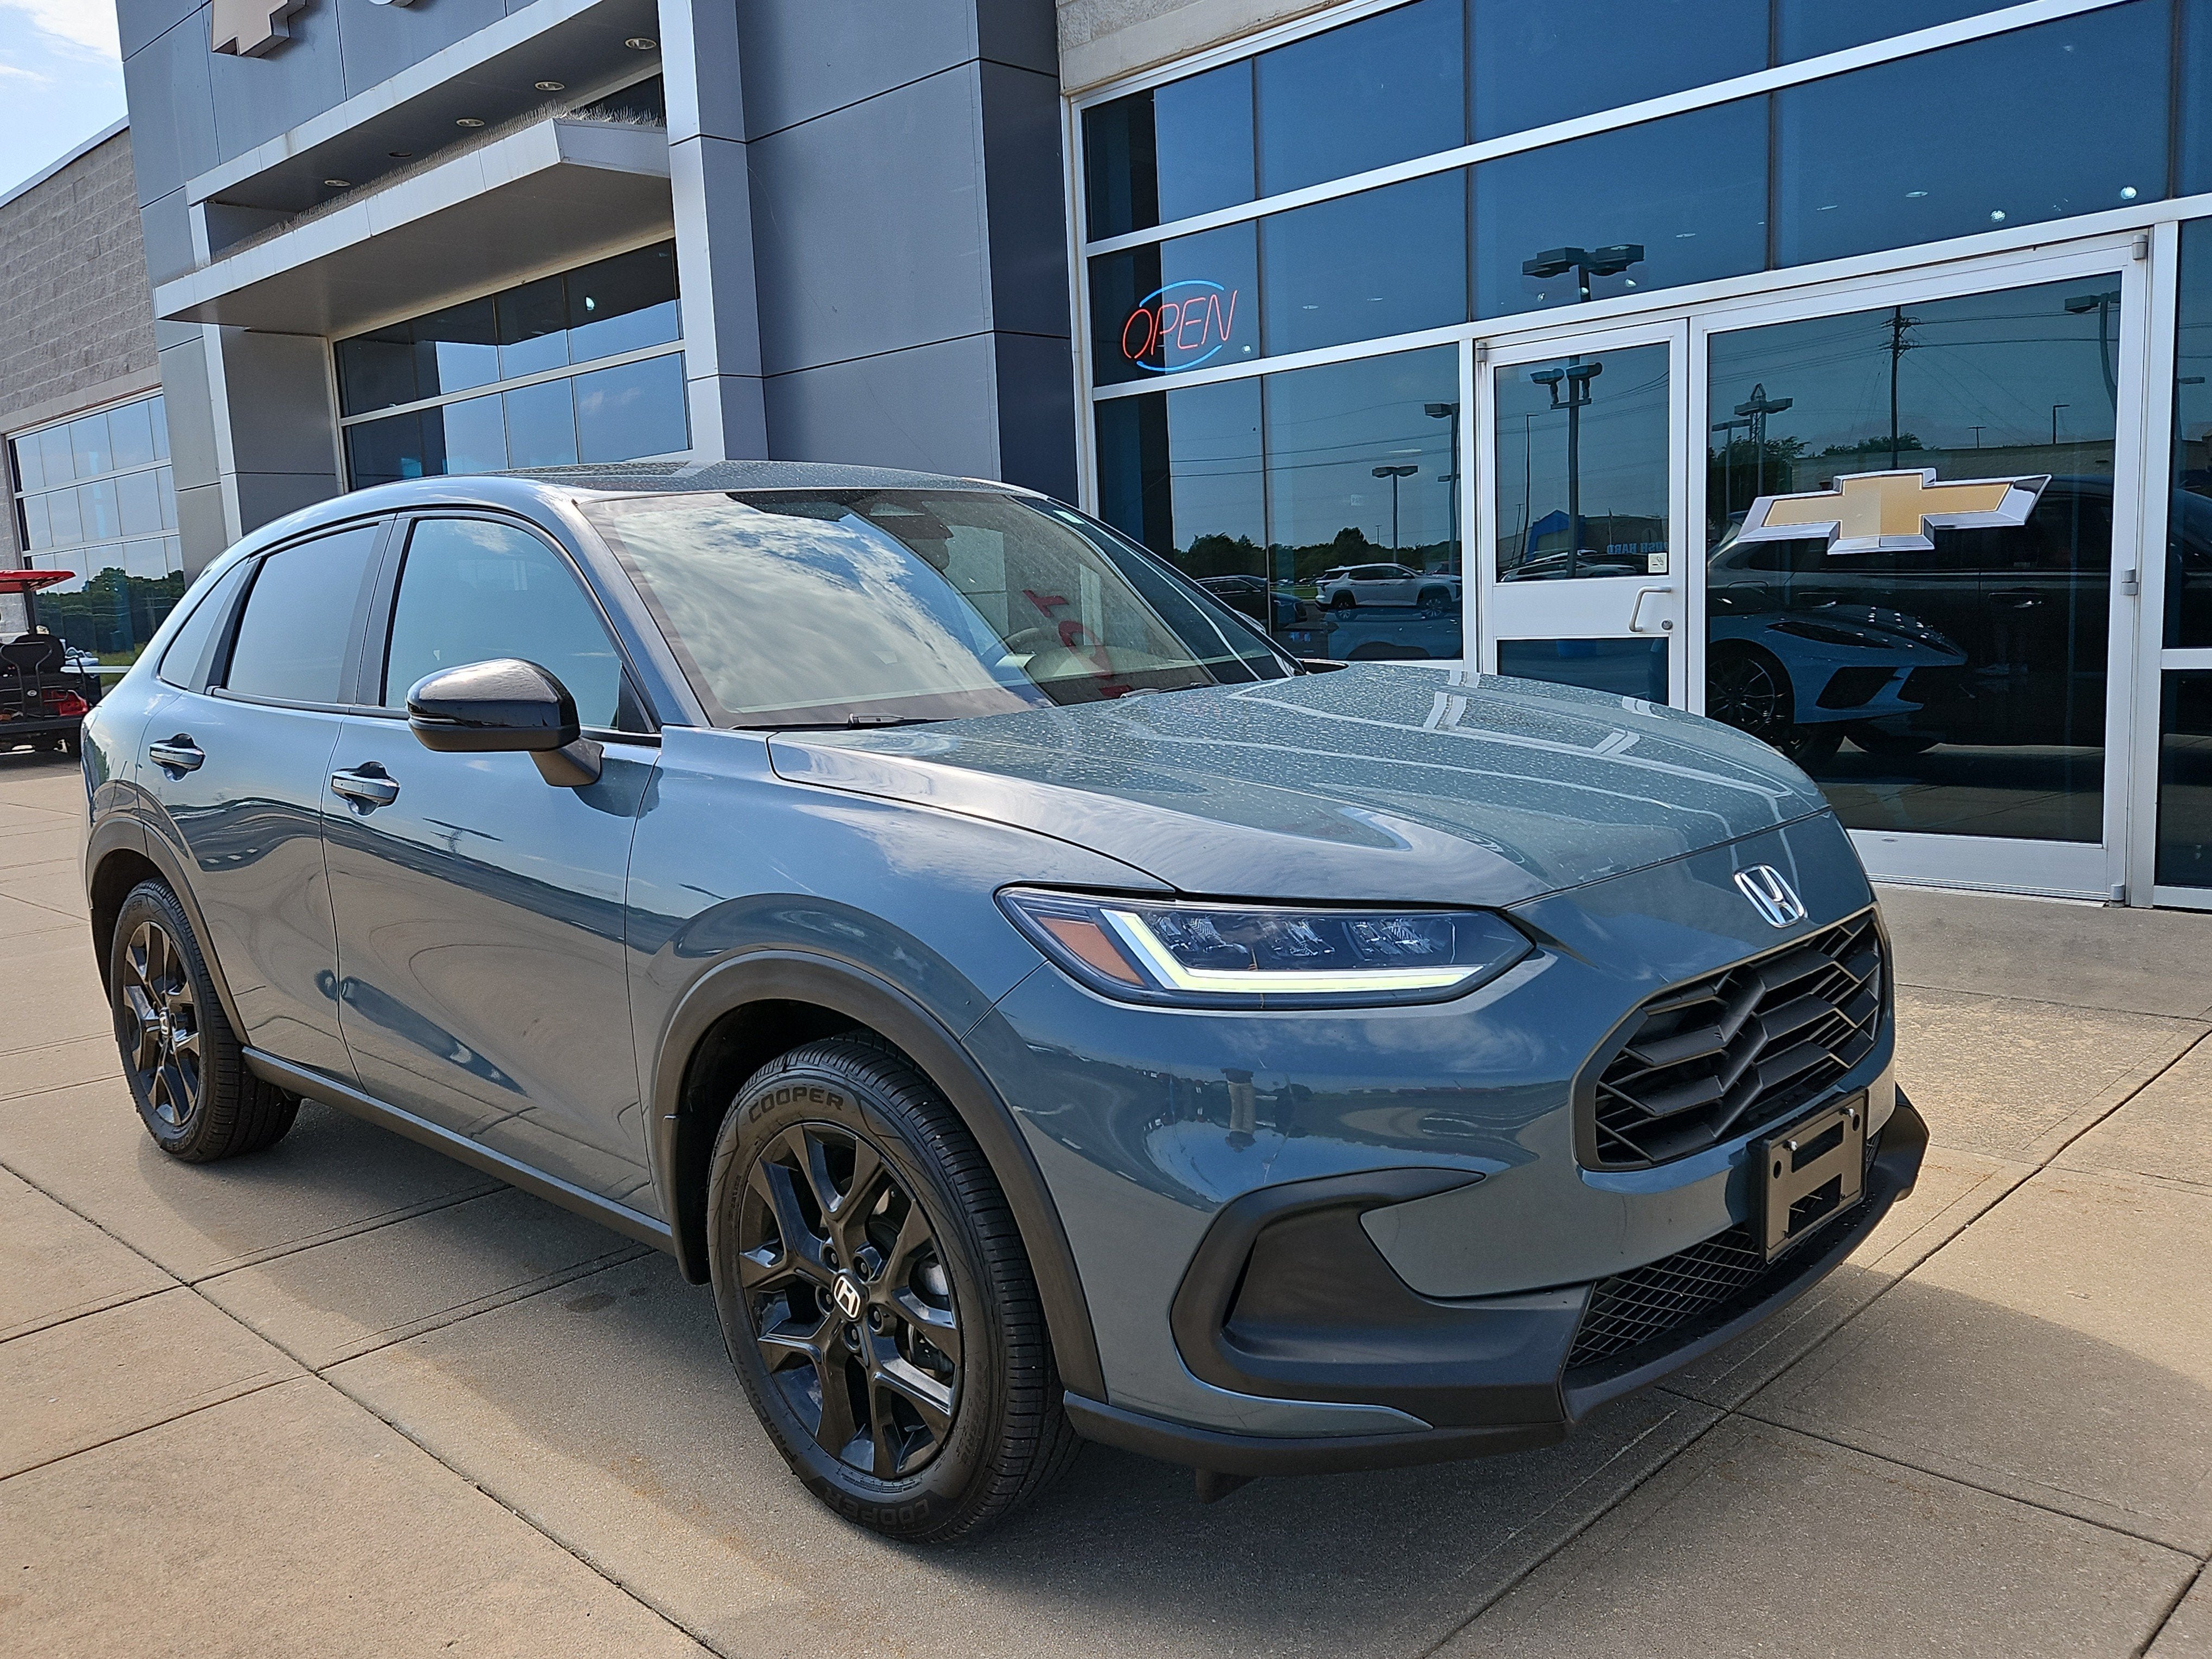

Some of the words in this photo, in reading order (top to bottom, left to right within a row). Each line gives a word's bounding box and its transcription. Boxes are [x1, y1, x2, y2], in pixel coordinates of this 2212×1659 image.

[1122, 290, 1238, 359] OPEN
[748, 1086, 844, 1123] COOPER
[824, 1487, 930, 1526] COOPER
